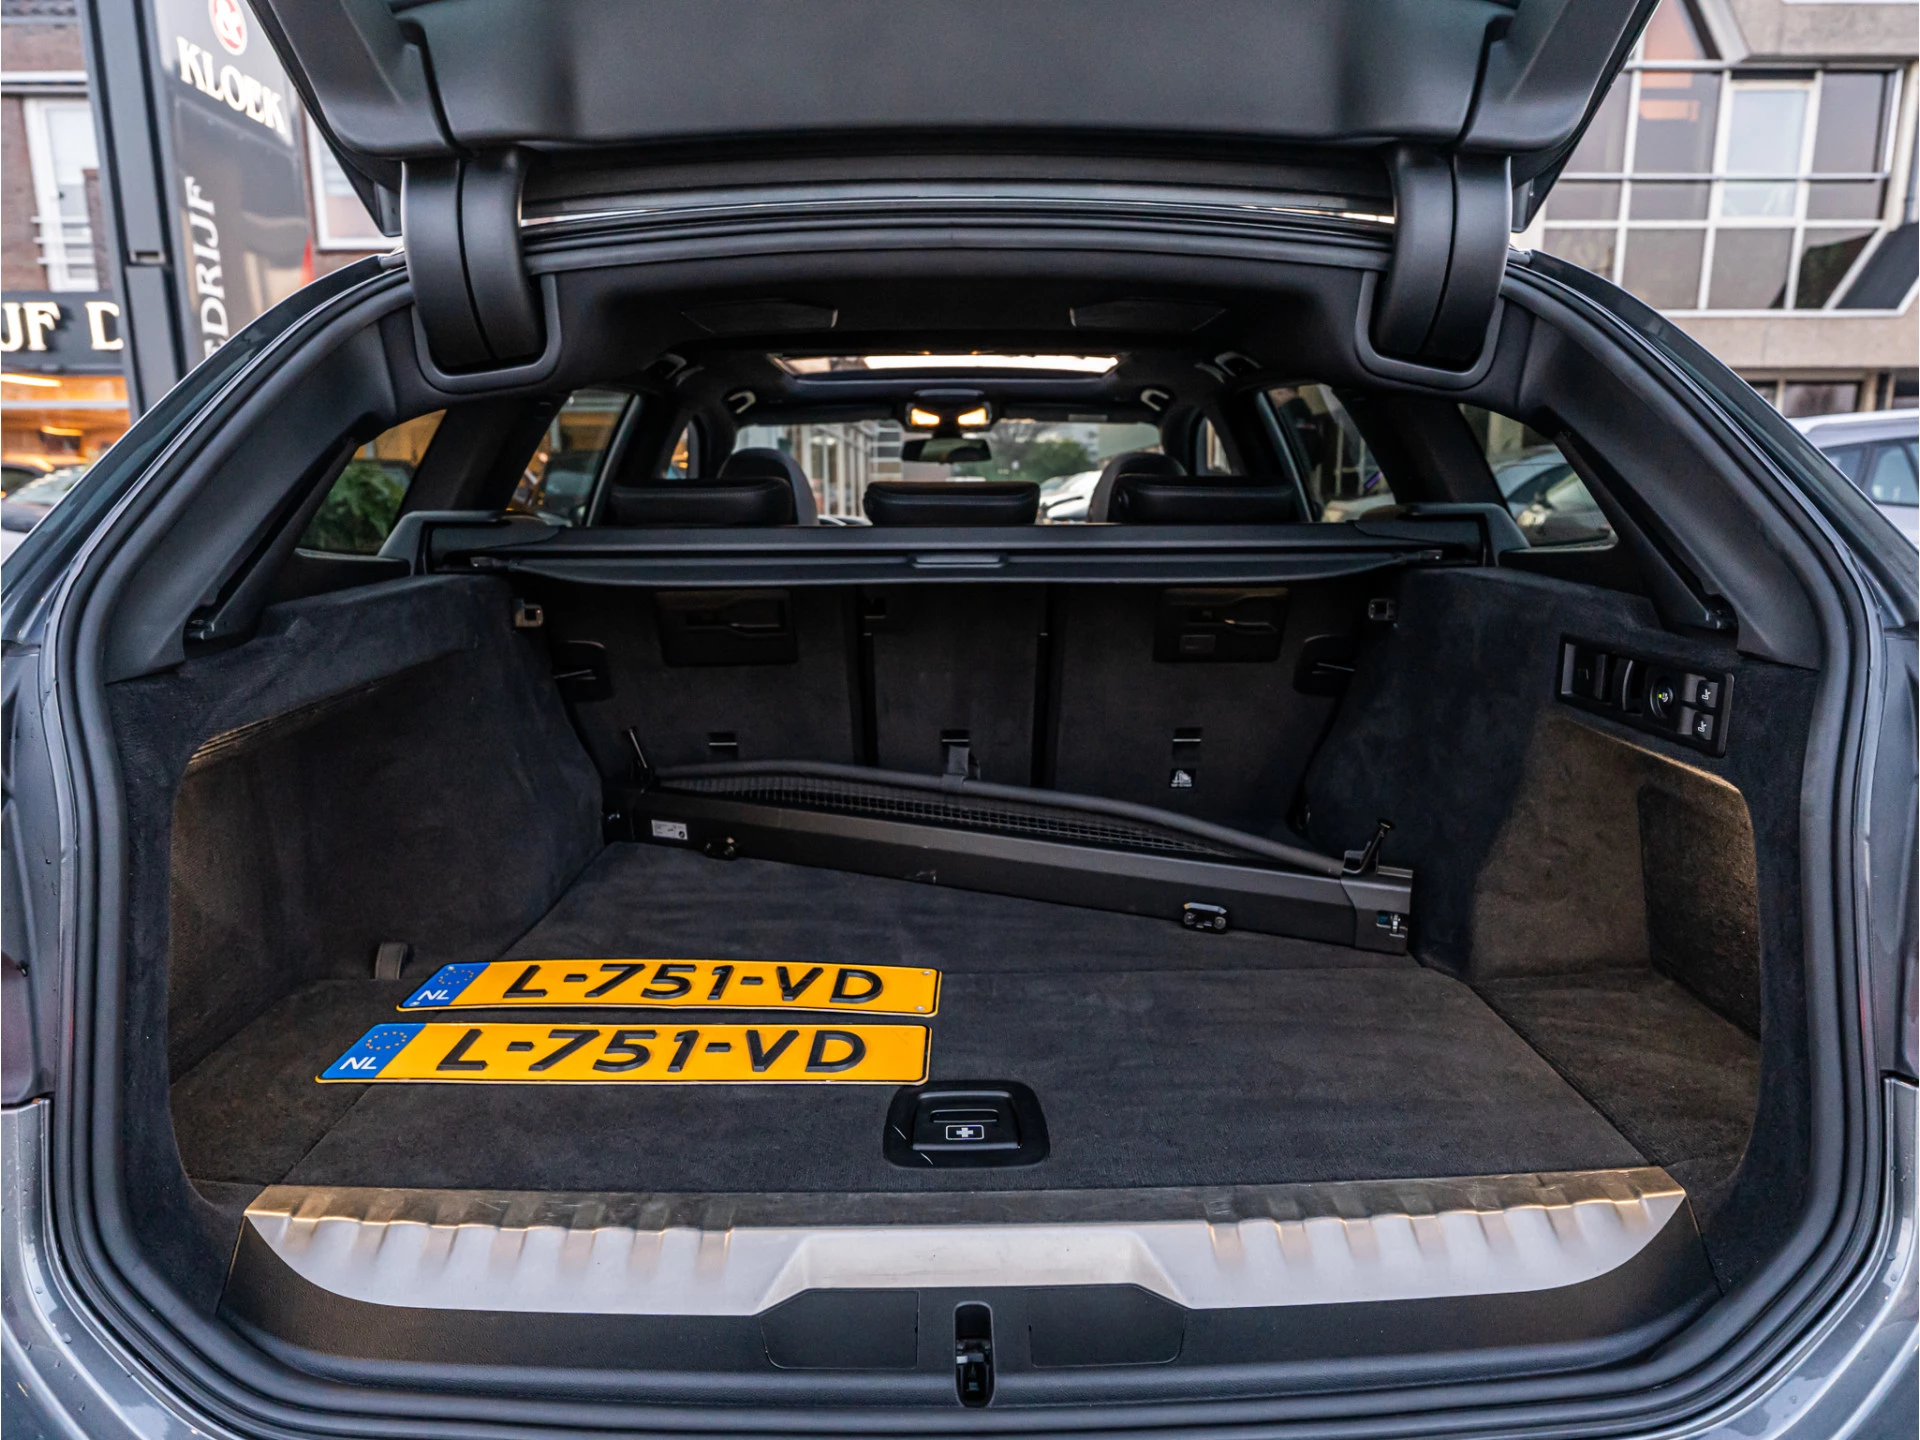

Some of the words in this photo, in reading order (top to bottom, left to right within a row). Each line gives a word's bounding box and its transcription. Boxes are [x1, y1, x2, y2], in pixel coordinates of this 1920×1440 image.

[176, 35, 287, 136] KLOEK
[417, 989, 449, 1001] NL
[502, 963, 883, 1001] L-751-VD
[339, 1057, 377, 1070] NL
[436, 1028, 867, 1072] L-751-VD
